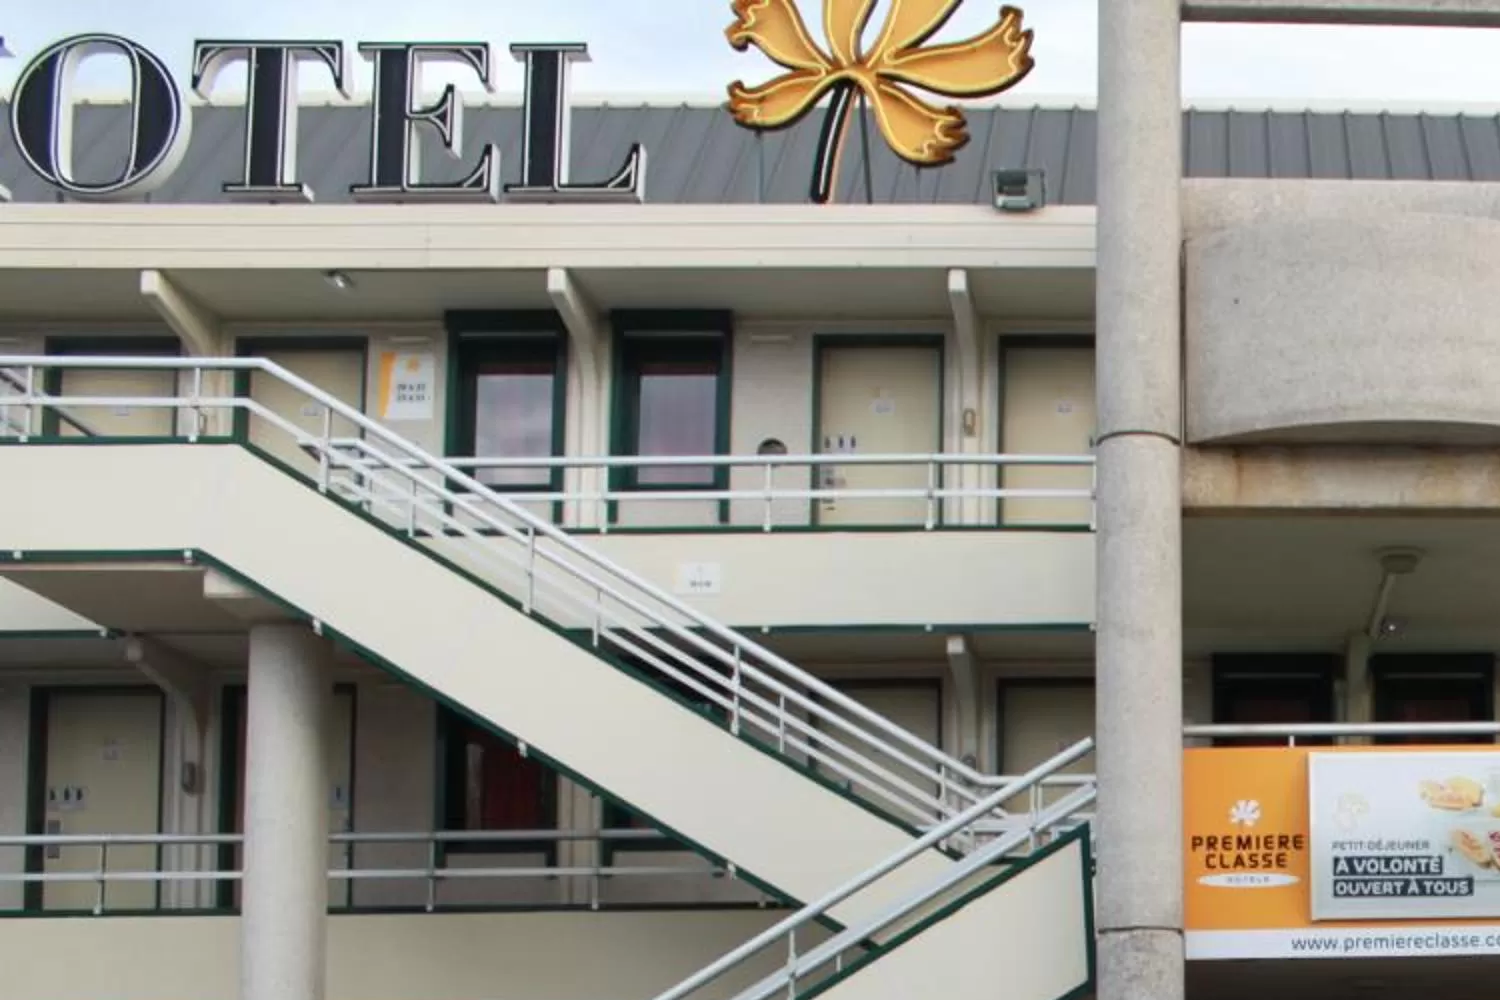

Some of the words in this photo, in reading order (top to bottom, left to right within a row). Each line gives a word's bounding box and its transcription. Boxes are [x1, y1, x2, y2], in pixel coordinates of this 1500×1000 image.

[0, 33, 648, 204] OTEL
[1191, 832, 1304, 852] PREMIERE
[1205, 853, 1288, 869] CLASSE
[1353, 855, 1441, 873] VOLONTÉ
[1335, 881, 1405, 895] OUVERT
[1407, 877, 1420, 895] À
[1423, 880, 1469, 894] TOUS
